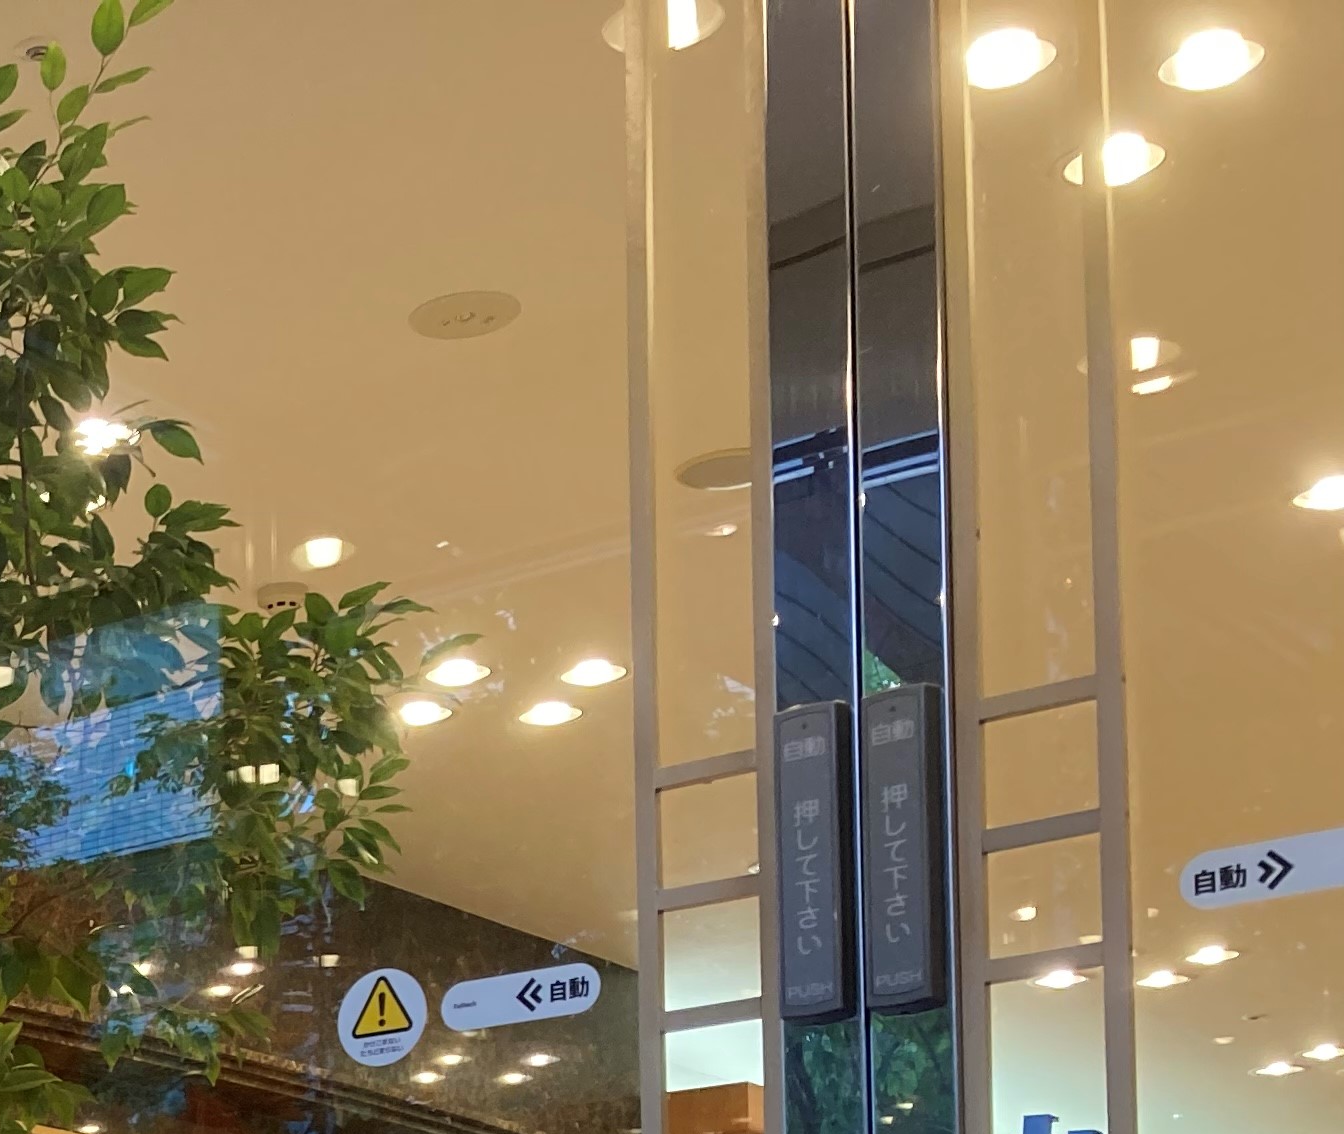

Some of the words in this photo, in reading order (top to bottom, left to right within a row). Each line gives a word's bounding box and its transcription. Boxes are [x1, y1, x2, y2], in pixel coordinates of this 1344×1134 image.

[871, 719, 915, 747] 自動
[783, 736, 826, 763] 自動
[792, 798, 823, 955] 押して下さい
[880, 783, 911, 944] 押して下さい
[1194, 863, 1248, 897] 自動
[549, 975, 590, 1003] 自動
[787, 981, 833, 999] PUSH
[875, 969, 922, 988] PUSH
